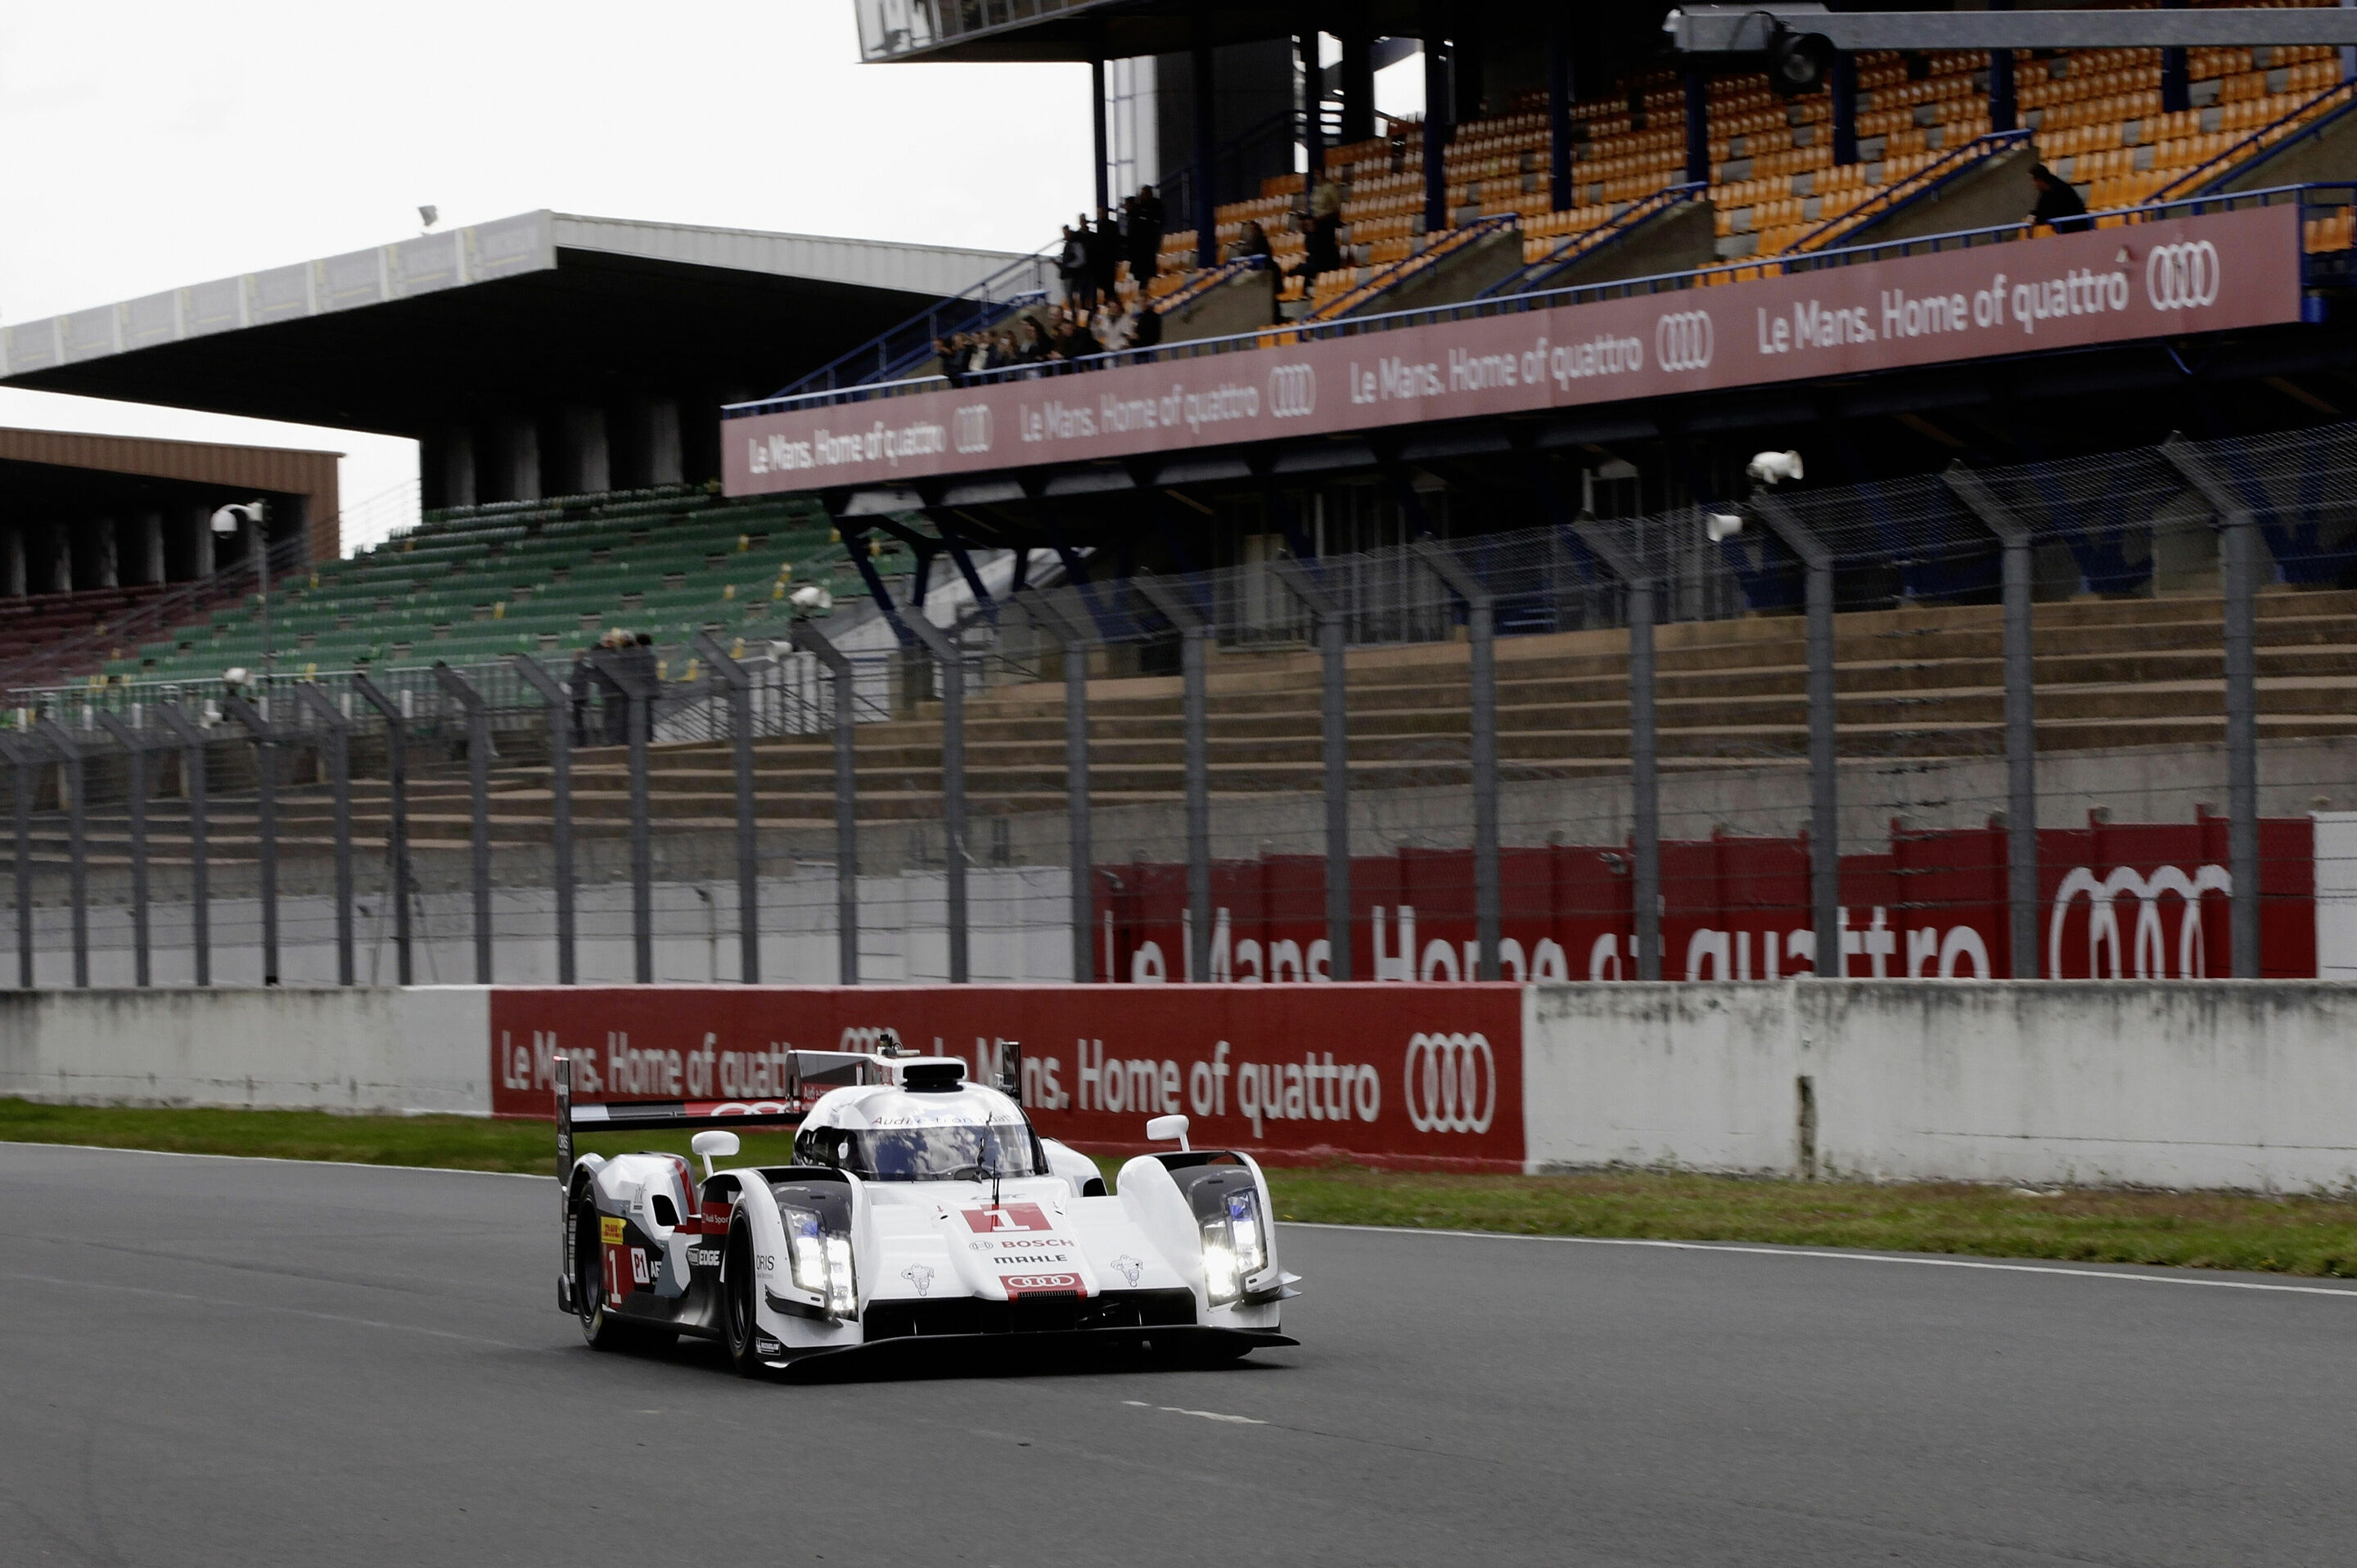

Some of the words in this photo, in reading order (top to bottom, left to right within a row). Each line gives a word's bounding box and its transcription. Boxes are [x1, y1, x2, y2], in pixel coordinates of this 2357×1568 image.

[1757, 307, 1789, 354] Le
[1794, 299, 1876, 349] Mans.
[1882, 289, 1967, 339] Home
[1973, 273, 2007, 327] of
[2012, 268, 2128, 334] quattro
[1350, 361, 1376, 404] Le
[1379, 357, 1445, 400] Mans.
[1449, 348, 1517, 391] Home
[1521, 336, 1548, 385] of
[1551, 333, 1643, 392] quattro
[1020, 403, 1043, 442] Le
[1043, 400, 1099, 439] Mans.
[1100, 393, 1156, 433] Home
[1158, 384, 1183, 426] of
[1184, 382, 1260, 435] quattro
[749, 438, 768, 474] Le
[814, 428, 863, 466] Home
[864, 420, 885, 461] of
[502, 1030, 530, 1090] Le
[534, 1030, 604, 1093] Mns.
[607, 1030, 683, 1097] Home
[687, 1032, 717, 1098] of
[976, 1036, 1069, 1110] Mns.
[1078, 1038, 1182, 1114] Home
[1189, 1040, 1230, 1116] of
[1237, 1051, 1381, 1138] quattro
[872, 1116, 910, 1125] Audi
[714, 1214, 730, 1225] Spor
[983, 1210, 1030, 1232] 1
[699, 1249, 720, 1266] EDGE
[994, 1255, 1068, 1264] MAHLE
[1002, 1240, 1075, 1249] BOSCH
[608, 1250, 622, 1304] 1
[633, 1253, 647, 1278] P1
